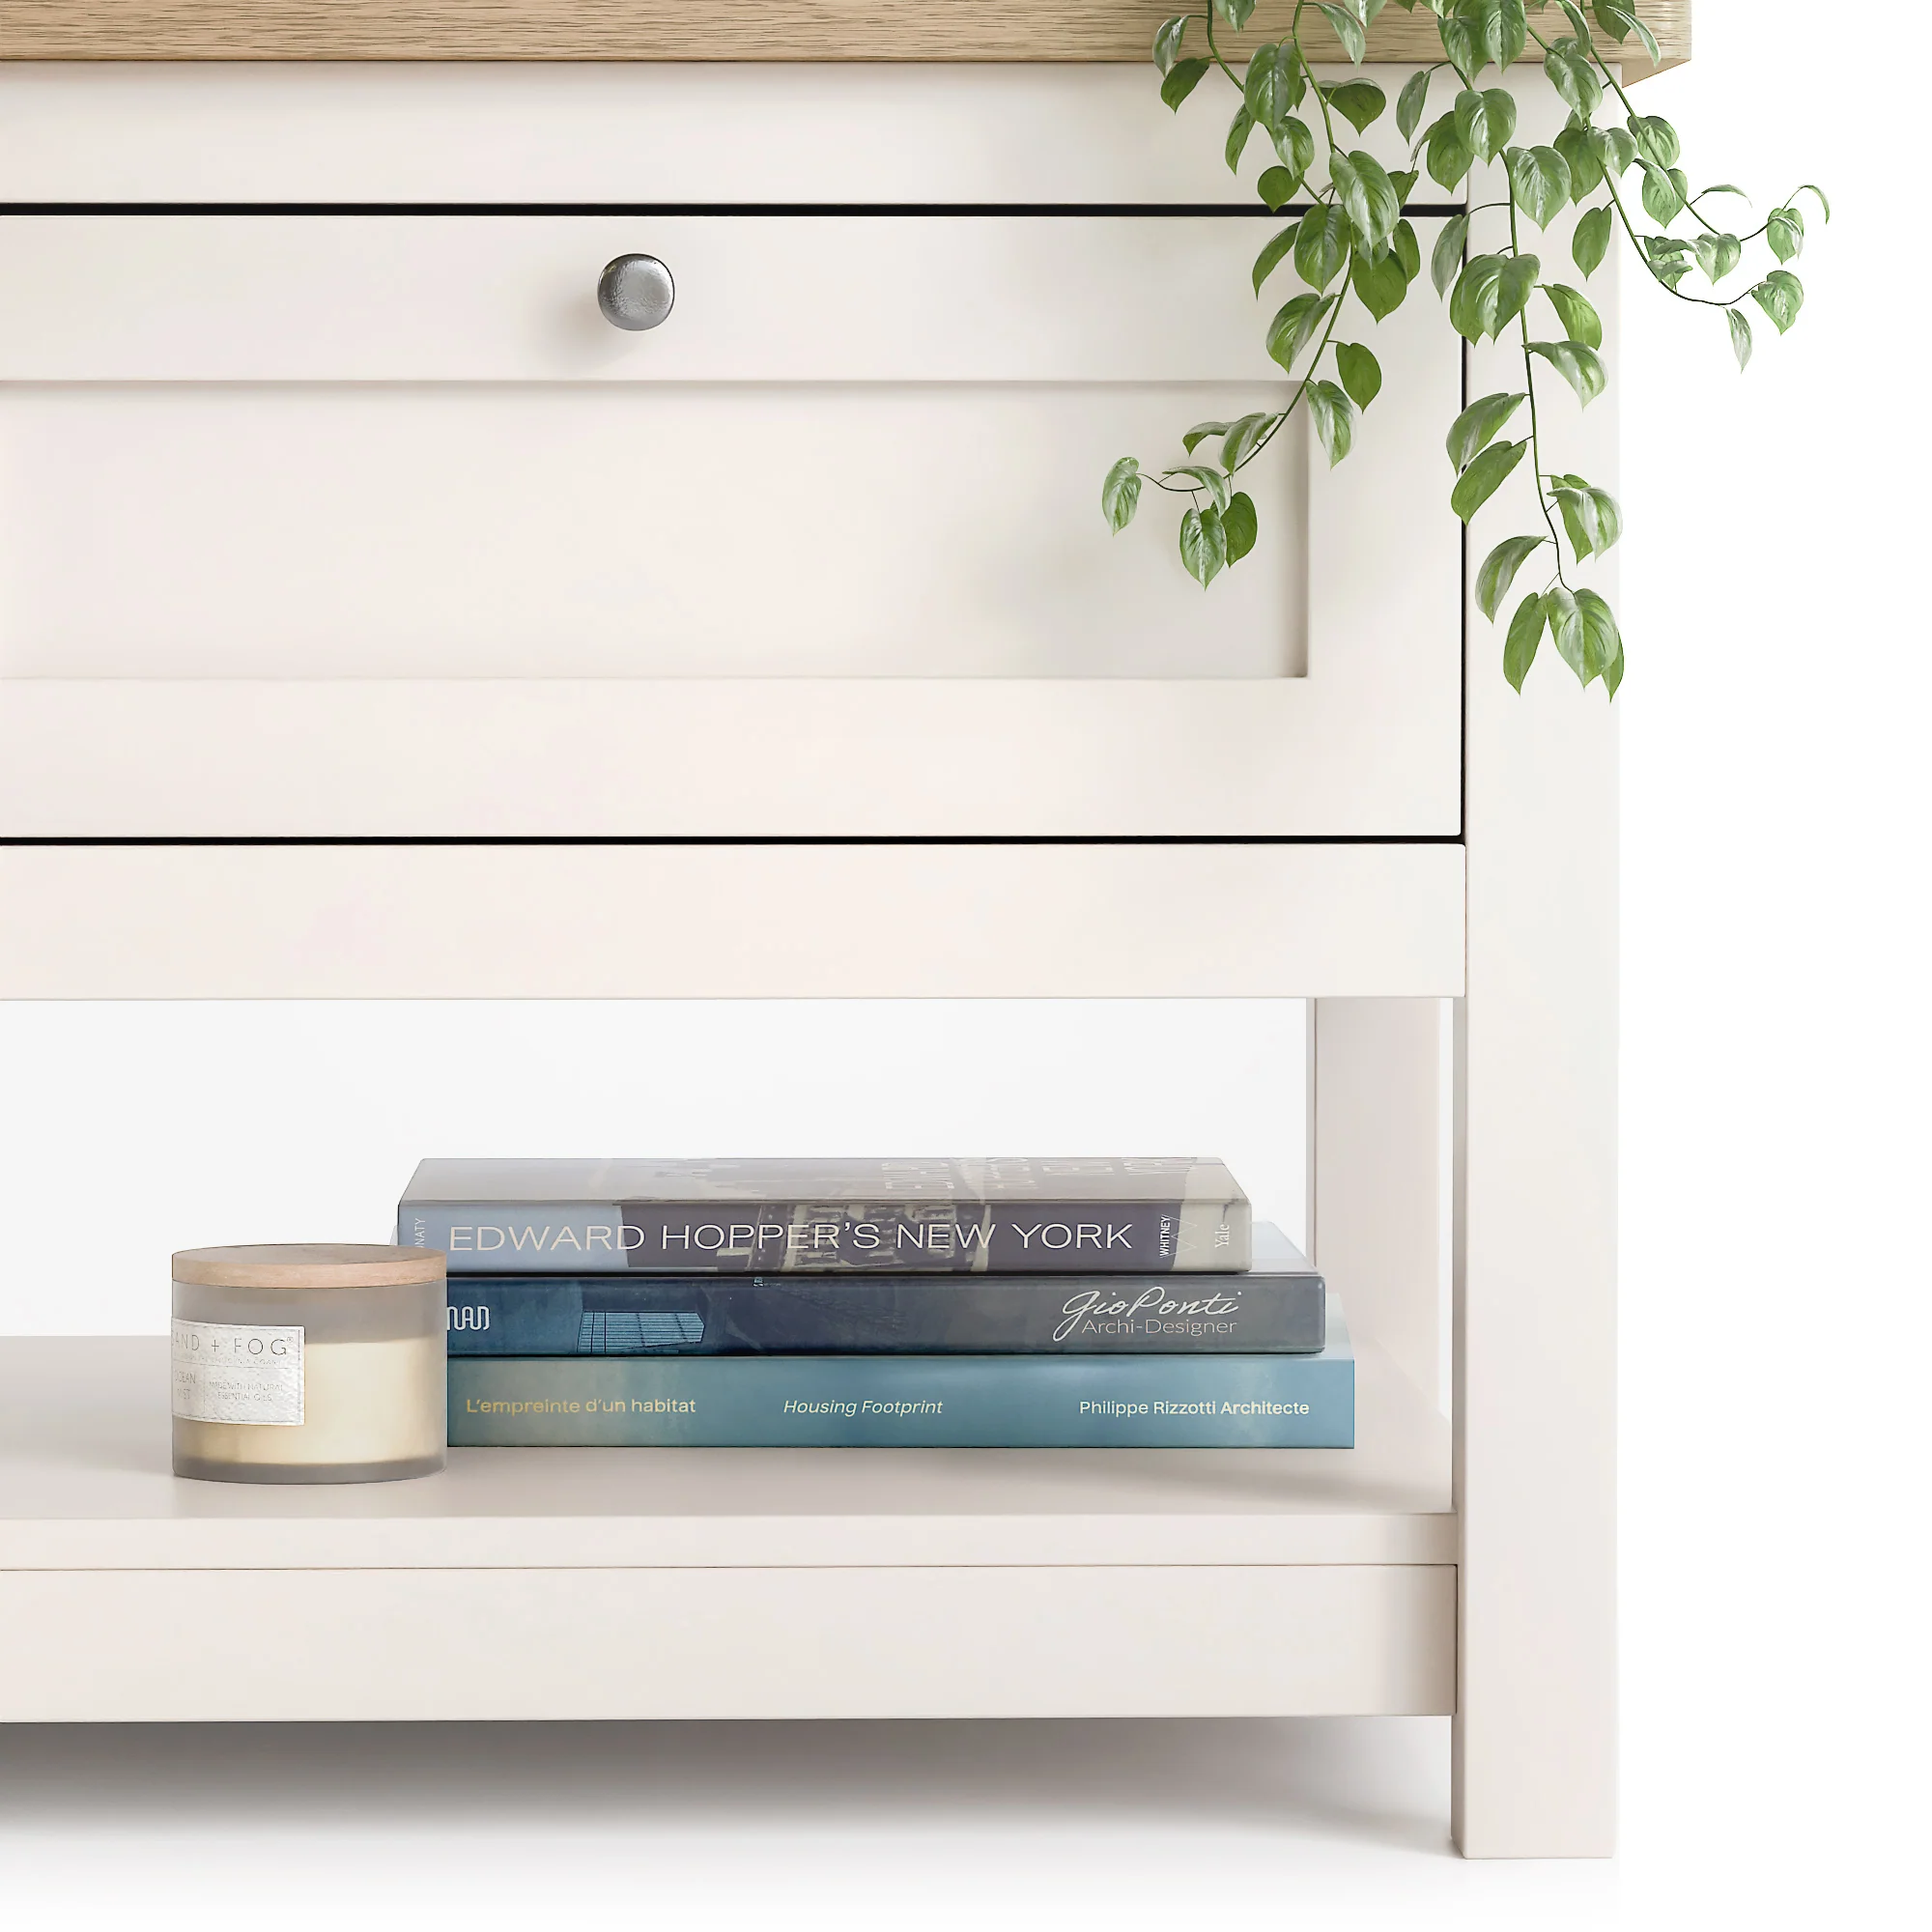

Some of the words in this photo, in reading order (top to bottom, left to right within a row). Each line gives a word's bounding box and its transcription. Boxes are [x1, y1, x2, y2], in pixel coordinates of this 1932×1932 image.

[414, 1218, 425, 1248] NATY
[449, 1225, 645, 1251] EDWARD
[663, 1222, 879, 1251] HOPPER'S
[896, 1224, 996, 1249] NEW
[1011, 1224, 1132, 1249] YORK
[1159, 1215, 1171, 1257] WHITNEY
[1214, 1223, 1230, 1248] Yale
[1081, 1319, 1237, 1336] Archi-Designer
[467, 1398, 580, 1416] L'empreinte
[585, 1399, 626, 1412] d'un
[631, 1399, 696, 1412] habitat
[783, 1400, 858, 1417] Housing
[861, 1400, 943, 1417] Footprint
[1079, 1401, 1149, 1417] Philippe
[1153, 1401, 1216, 1414] Rizzotti
[1220, 1401, 1310, 1414] Architecte
